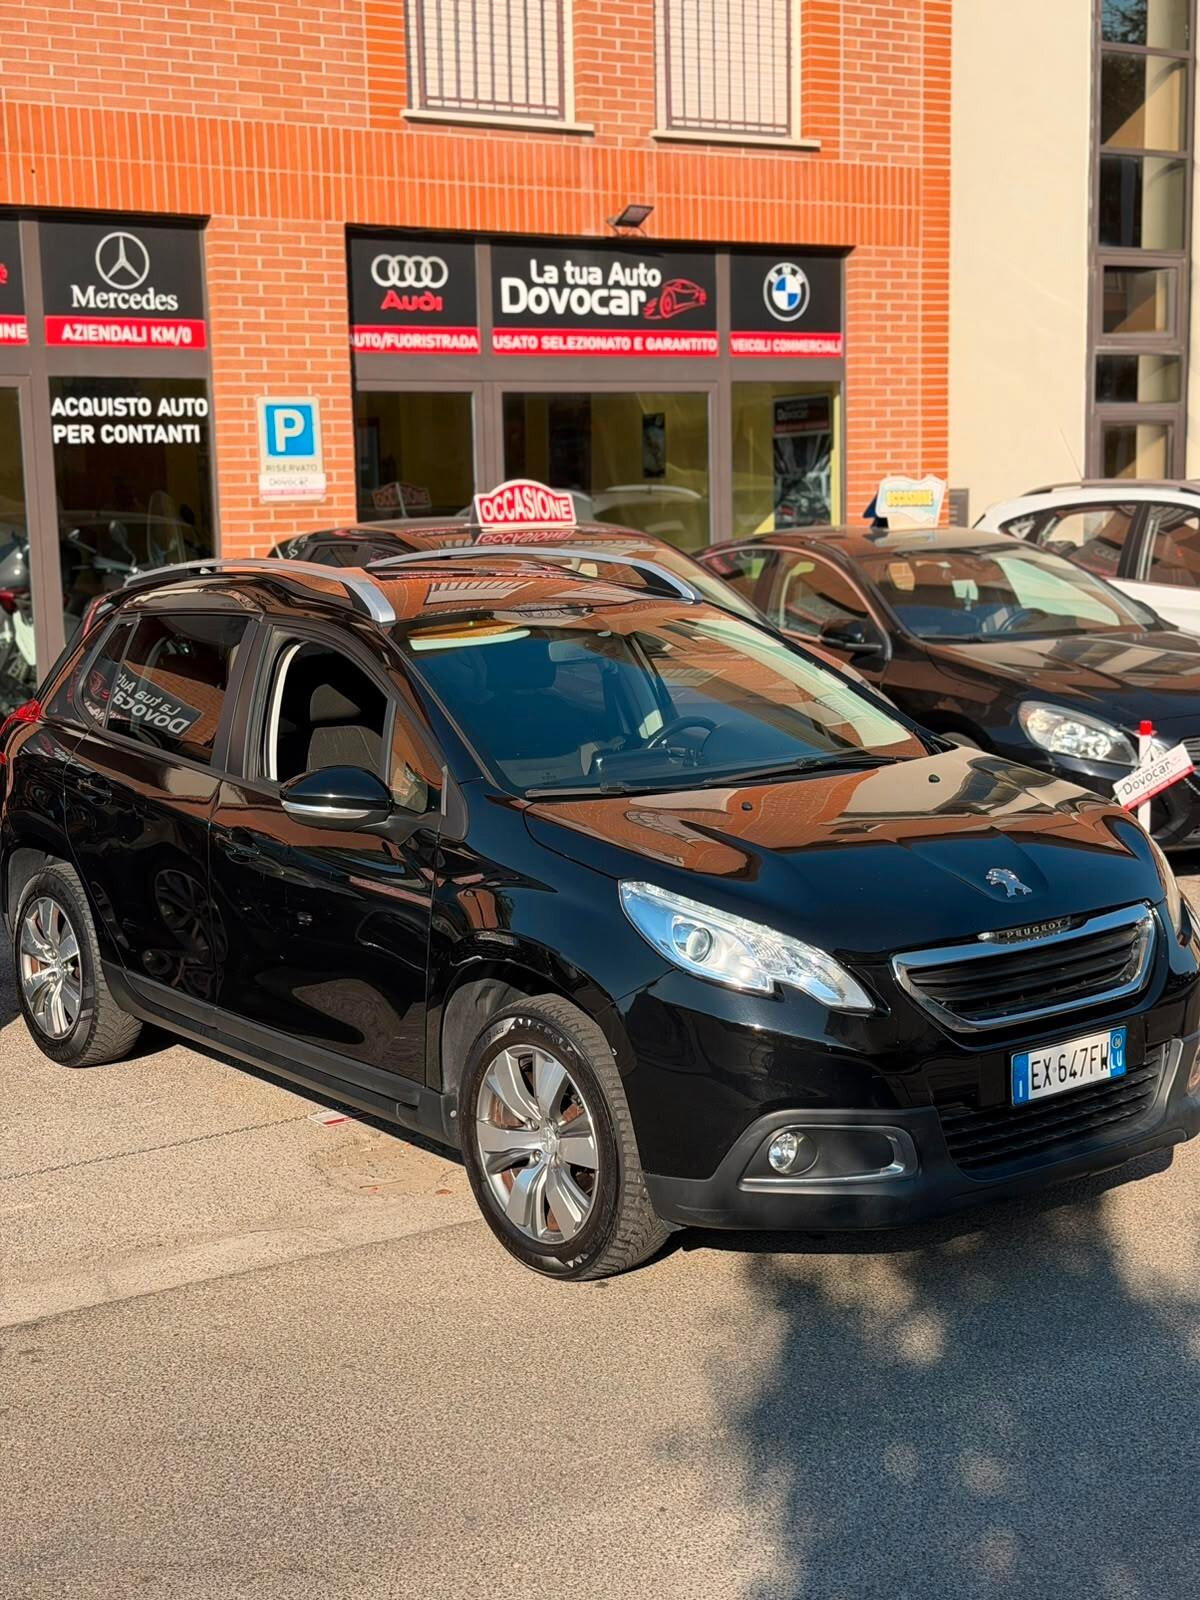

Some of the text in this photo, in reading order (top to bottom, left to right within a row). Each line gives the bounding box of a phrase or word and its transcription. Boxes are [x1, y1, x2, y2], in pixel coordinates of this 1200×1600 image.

[529, 258, 662, 288] La tua Auto
[70, 284, 179, 311] Mercedes
[381, 289, 444, 312] Audi
[500, 277, 648, 317] Dovocar
[61, 324, 193, 346] AZIENDALI KM/0
[492, 335, 718, 352] USATO SELEZIONATO E GARANTITO
[51, 397, 208, 417] ACQUISTO AUTO
[53, 424, 201, 444] PER CONTANTI
[274, 409, 305, 453] P
[265, 464, 318, 473] RISERVATO
[481, 487, 573, 521] OCCASIONE
[1122, 760, 1171, 796] Dovocar
[1006, 919, 1063, 938] PEUGEOT
[1031, 1057, 1052, 1091] EX
[1058, 1041, 1109, 1084] 647FW
